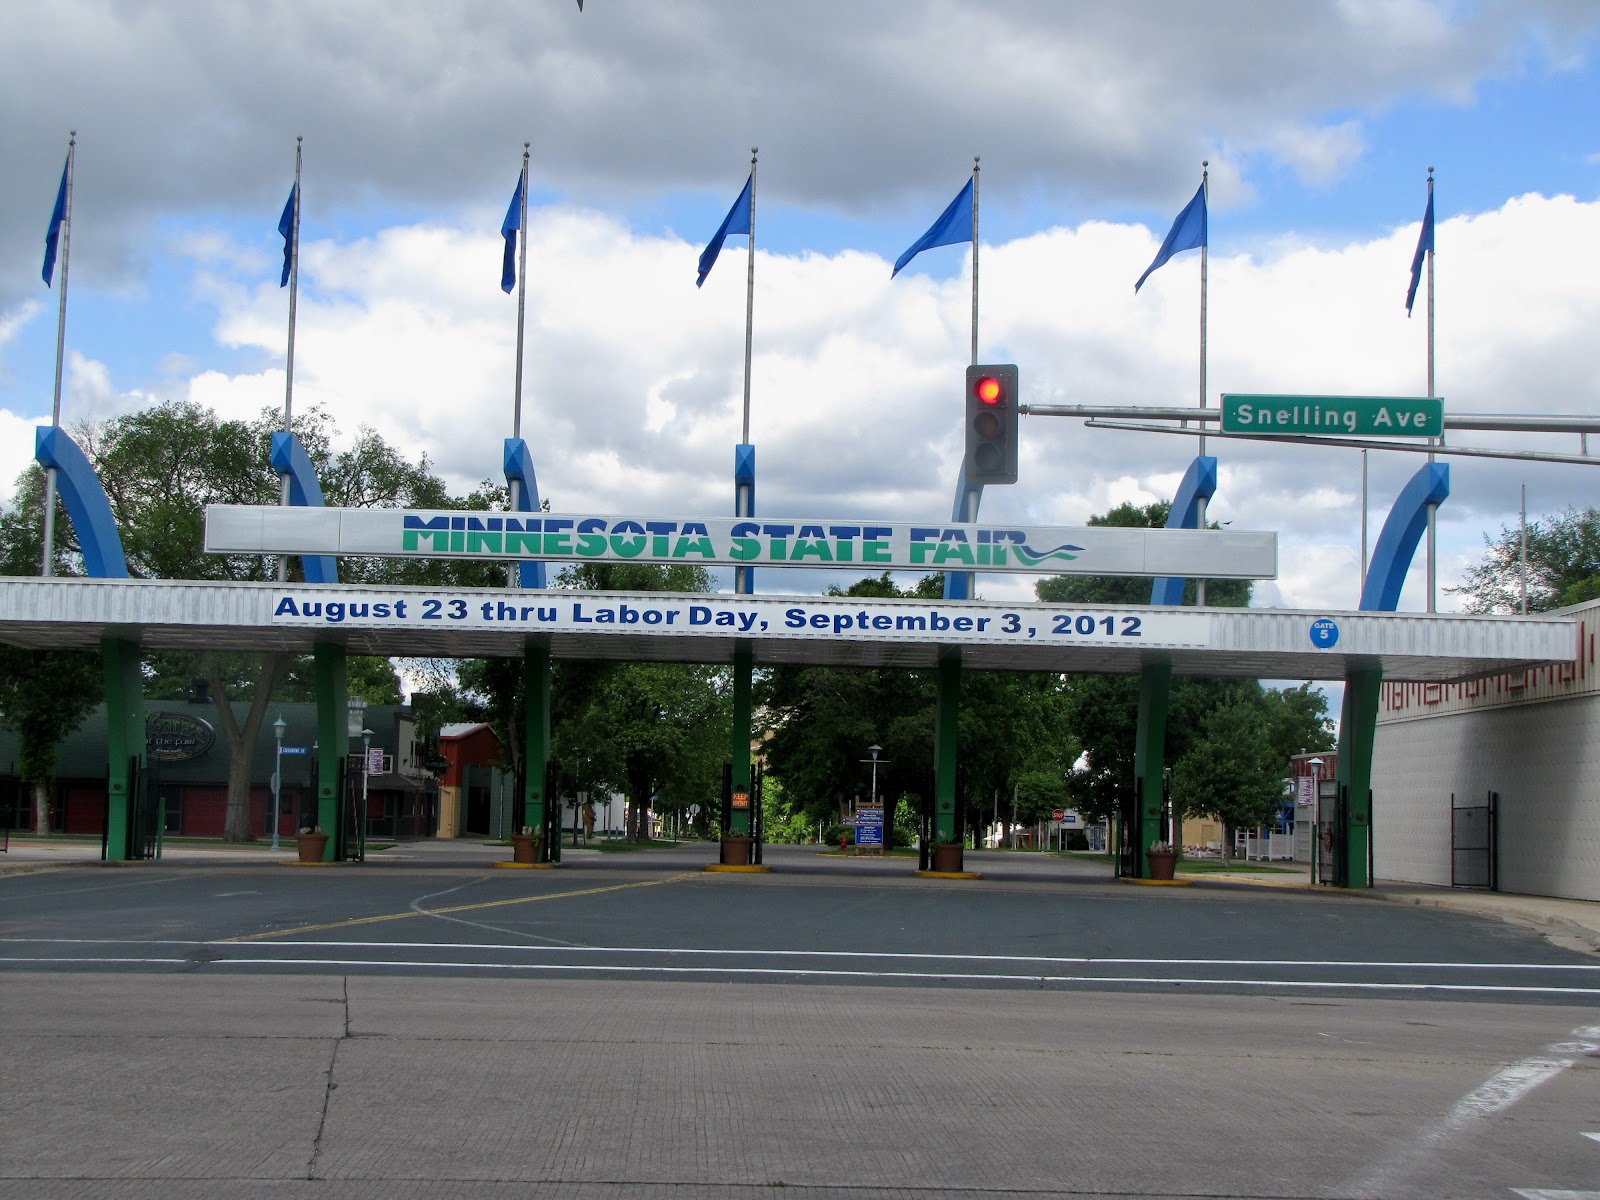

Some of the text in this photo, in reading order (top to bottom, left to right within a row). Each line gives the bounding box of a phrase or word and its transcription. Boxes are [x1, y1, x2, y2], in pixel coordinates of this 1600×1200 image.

[1237, 404, 1427, 432] Snelling Ave
[403, 515, 1046, 566] MINNESOTA STATE FAIR
[274, 597, 1142, 638] August 23 thru Labor Day, September 3, 2012
[1320, 629, 1329, 639] 5
